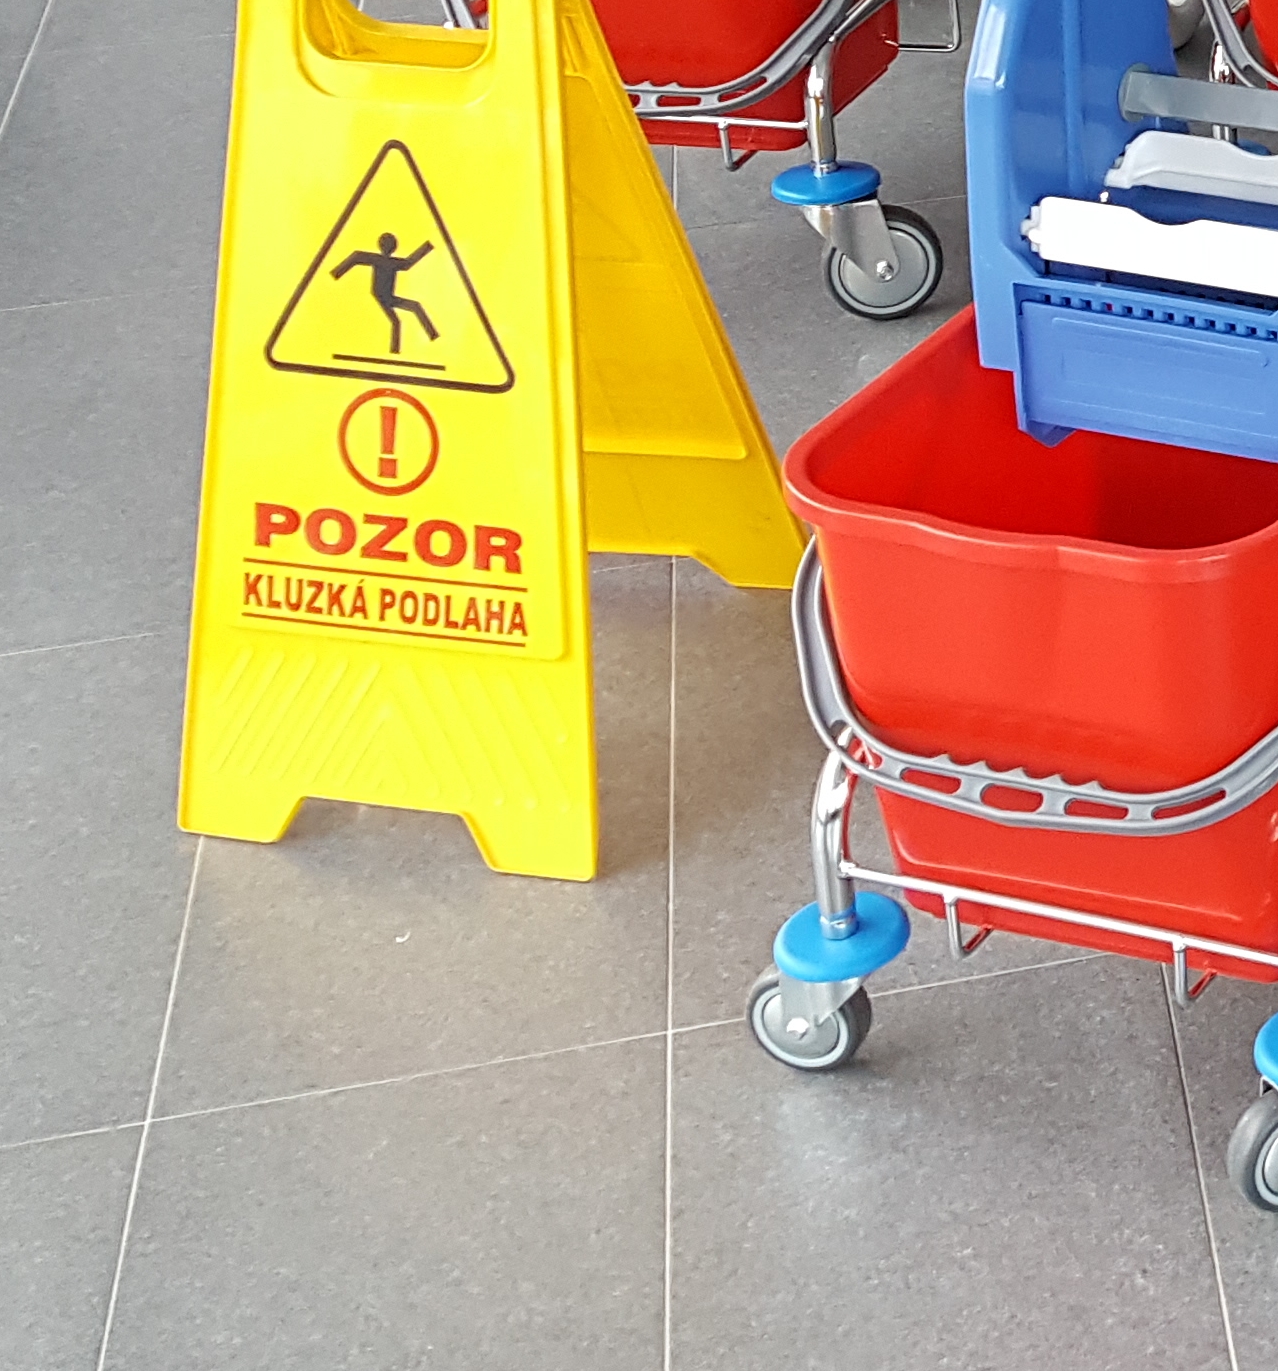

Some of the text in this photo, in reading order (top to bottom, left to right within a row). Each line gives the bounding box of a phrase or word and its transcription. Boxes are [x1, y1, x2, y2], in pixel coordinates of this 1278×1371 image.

[254, 502, 523, 575] POZOR
[243, 572, 528, 637] KLUZKÁ PODLAHA
